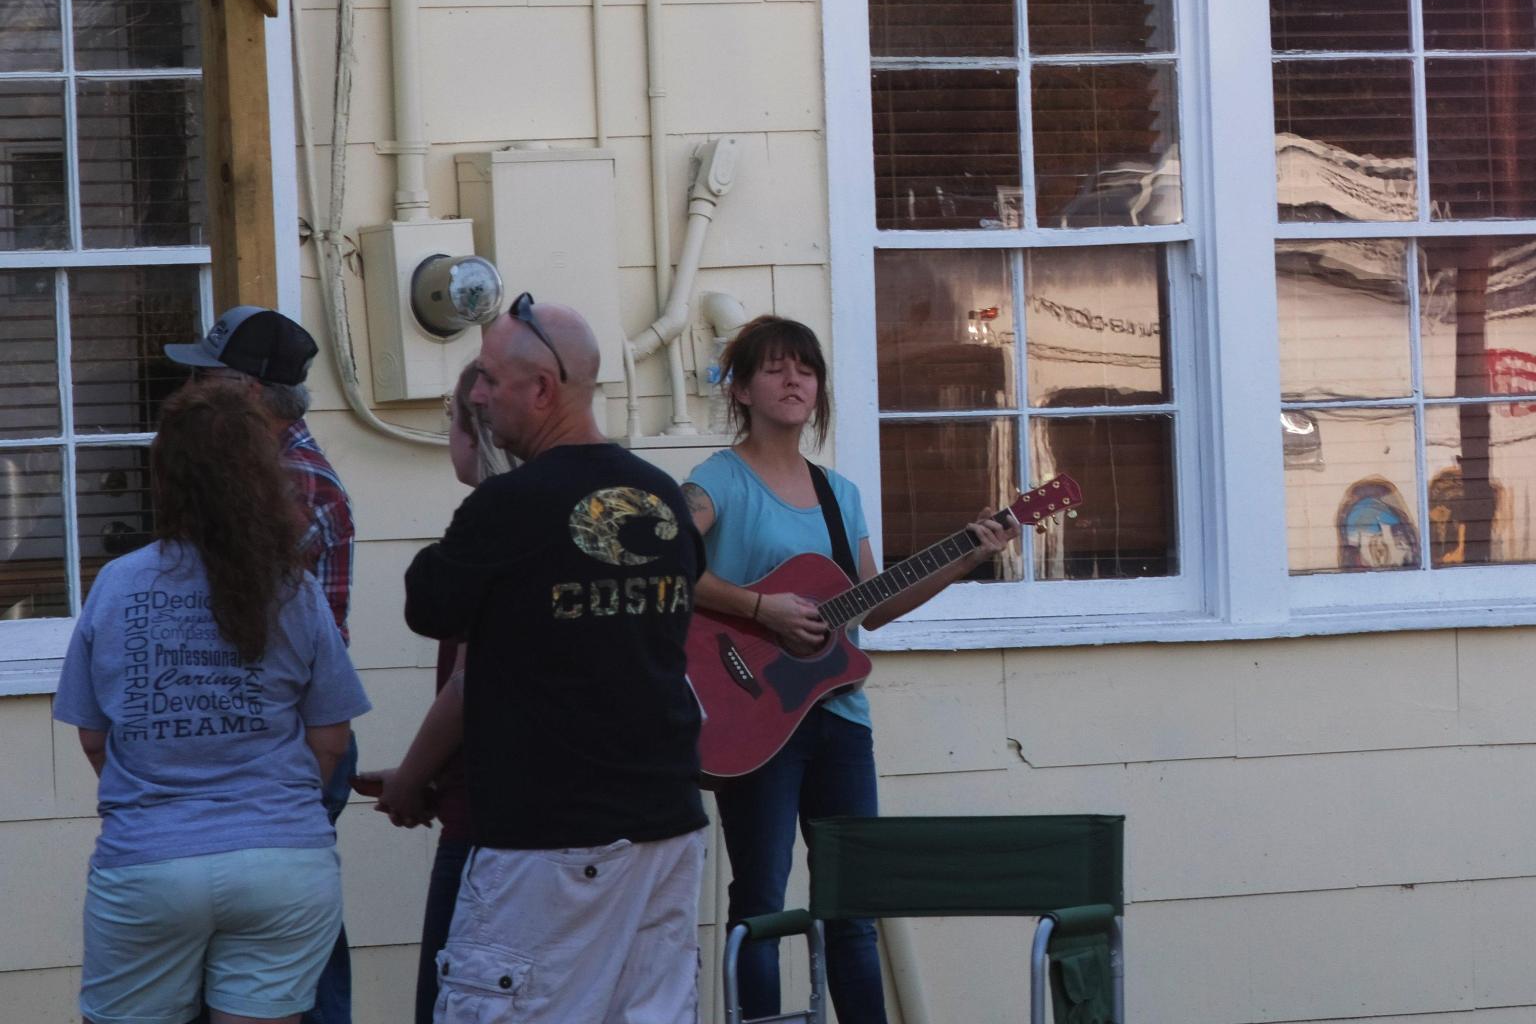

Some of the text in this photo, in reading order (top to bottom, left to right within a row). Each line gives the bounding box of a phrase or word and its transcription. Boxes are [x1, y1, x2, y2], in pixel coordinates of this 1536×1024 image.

[152, 590, 212, 609] Dedic
[552, 576, 688, 619] COSTA
[122, 591, 149, 742] PERIOPERATIVE
[154, 668, 243, 692] Caring
[152, 690, 244, 715] Devoted
[245, 658, 269, 732] killed
[152, 715, 246, 740] TEAM
